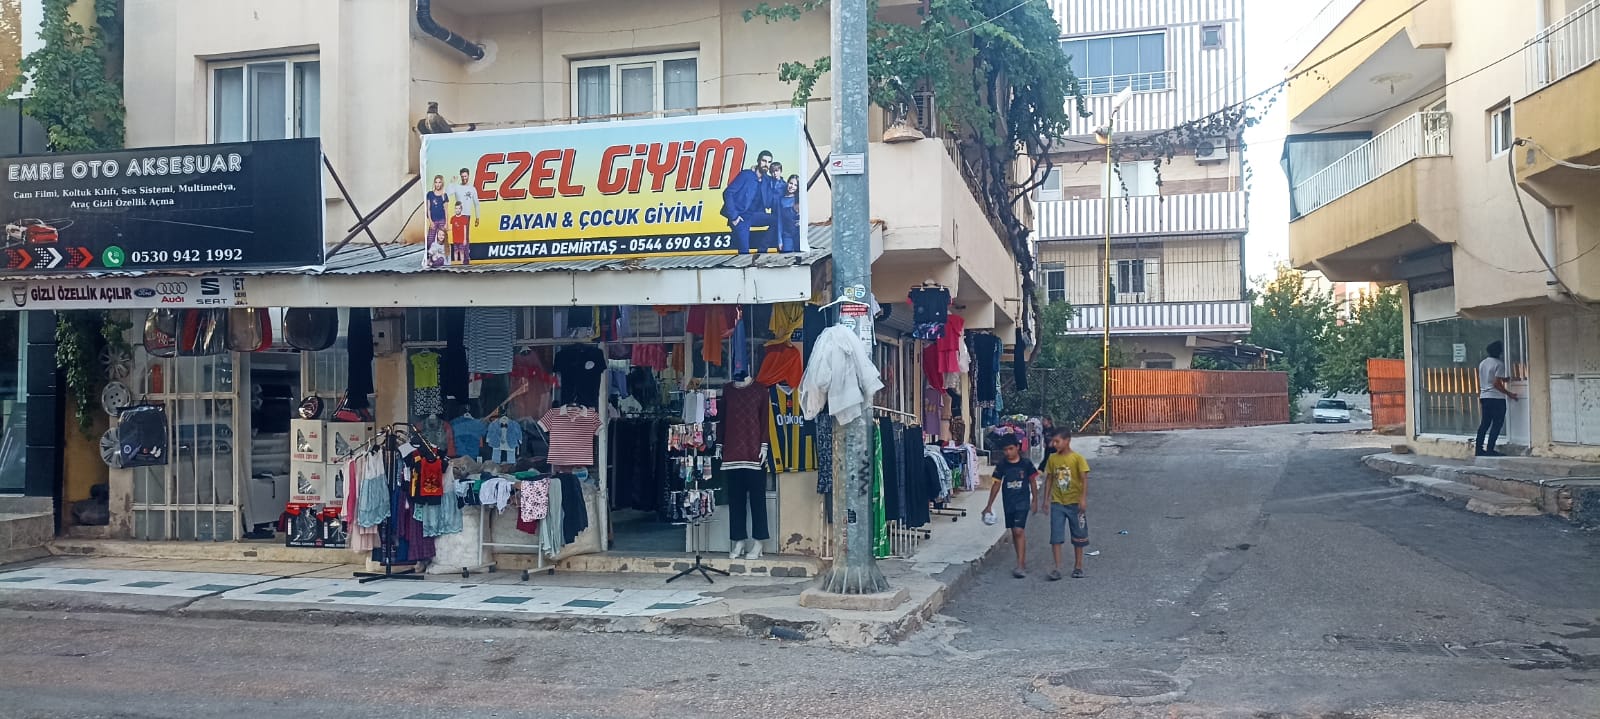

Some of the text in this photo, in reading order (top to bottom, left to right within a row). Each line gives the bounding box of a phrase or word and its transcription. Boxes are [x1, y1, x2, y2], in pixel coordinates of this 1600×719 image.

[8, 153, 242, 182] EMRE OTO AKSESUAR
[473, 148, 586, 202] EZEL
[13, 190, 33, 199] Cam
[35, 189, 60, 199] Filmi,
[62, 188, 92, 197] Koltuk
[121, 186, 137, 195] Ses
[139, 184, 176, 194] Sistemi,
[178, 182, 236, 193] Multimedya,
[70, 197, 175, 210] Araç Gizli Özellik Açma
[499, 200, 704, 231] BAYAN & ÇOCUK GİYİMİ
[131, 248, 243, 263] 0530 942 1992
[488, 243, 548, 258] MUSTAFA
[551, 238, 618, 256] DEMİRTAŞ
[629, 237, 662, 251] 0544
[665, 236, 691, 250] 690
[694, 235, 711, 249] 63
[714, 234, 731, 248] 63
[31, 284, 132, 303] GİZLİ ÖZELLİK AÇILIR
